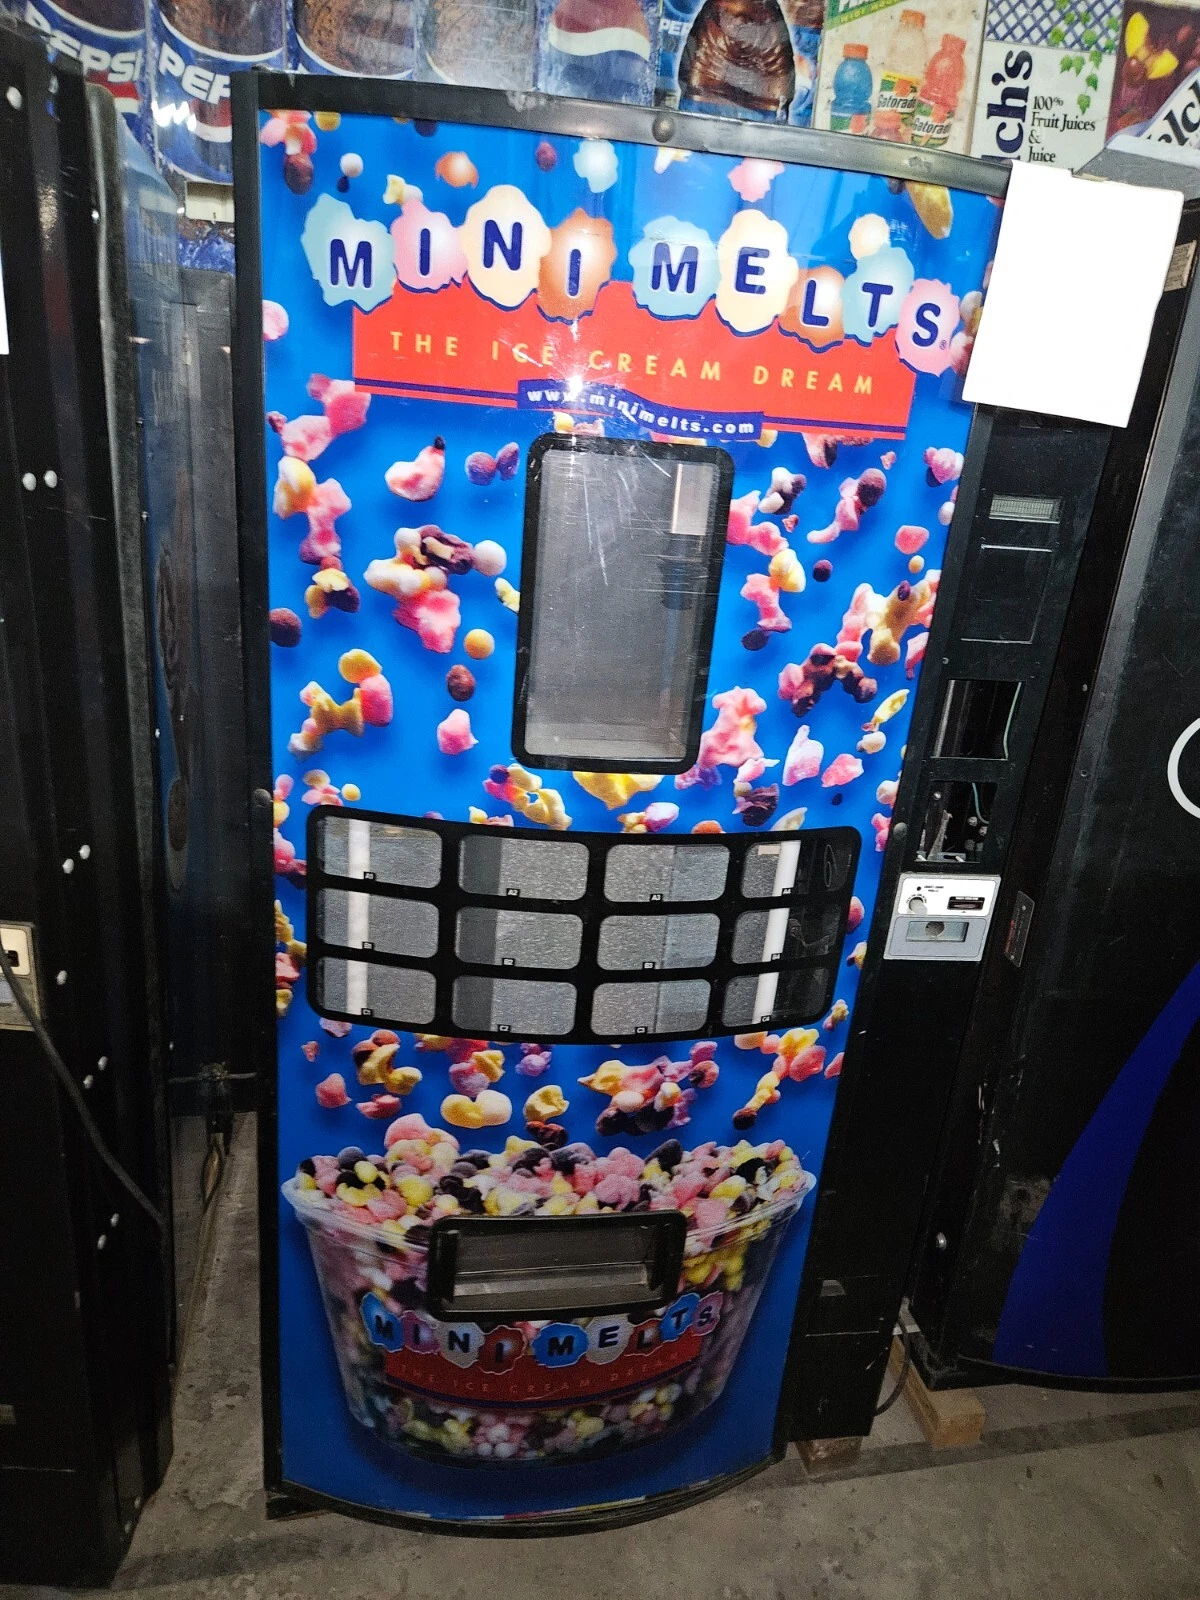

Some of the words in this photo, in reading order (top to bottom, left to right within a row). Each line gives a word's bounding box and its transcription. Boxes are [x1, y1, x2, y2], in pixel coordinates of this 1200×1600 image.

[1032, 96, 1064, 111] 100%
[1031, 112, 1059, 129] Fruit
[1060, 114, 1096, 132] Juices
[1028, 129, 1042, 144] &
[1028, 146, 1056, 163] Juice
[330, 219, 582, 297] MINI
[651, 242, 941, 348] MELTS
[390, 331, 458, 357] THE
[491, 340, 554, 366] ICE
[588, 350, 721, 382] CREAM
[753, 365, 873, 396] DREAM
[375, 1315, 504, 1363] MINI
[547, 1305, 713, 1357] MELTS
